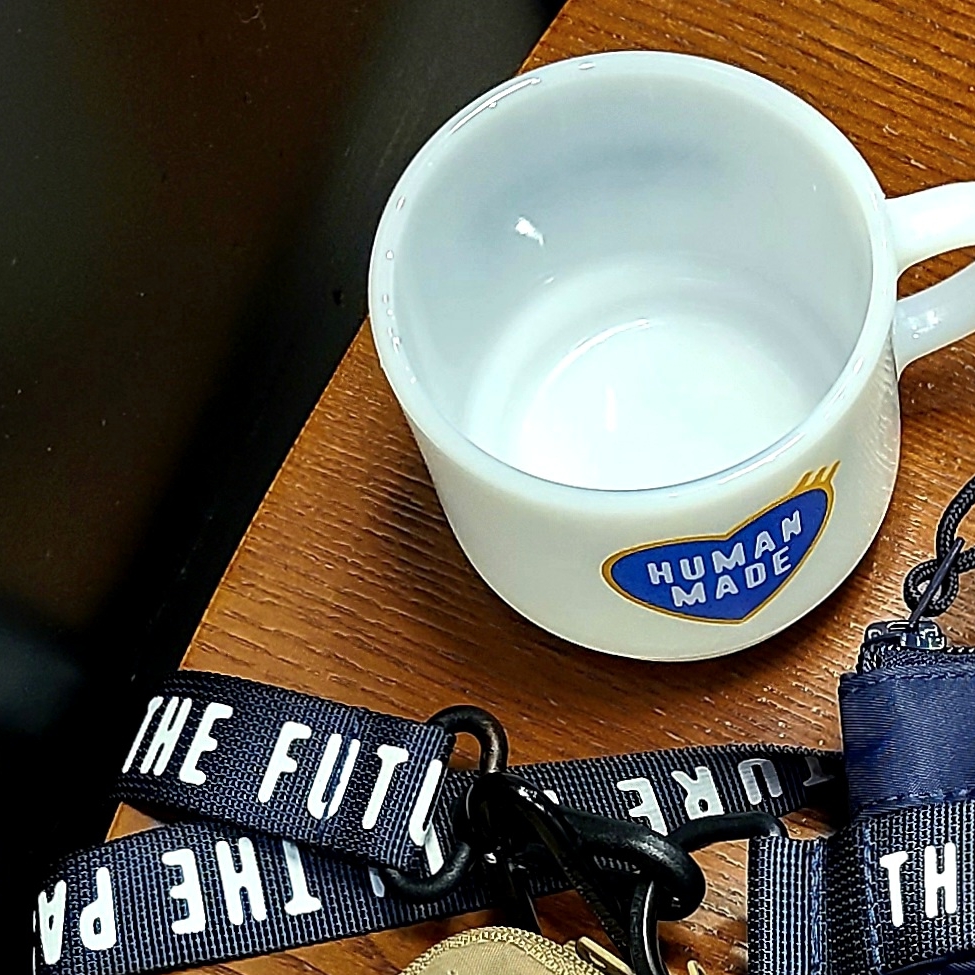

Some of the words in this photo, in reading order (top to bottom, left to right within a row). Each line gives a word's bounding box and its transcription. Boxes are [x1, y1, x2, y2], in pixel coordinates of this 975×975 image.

[647, 510, 801, 584] HUMAN
[671, 546, 792, 607] MADE
[122, 696, 233, 785] THE
[161, 837, 321, 935] THE
